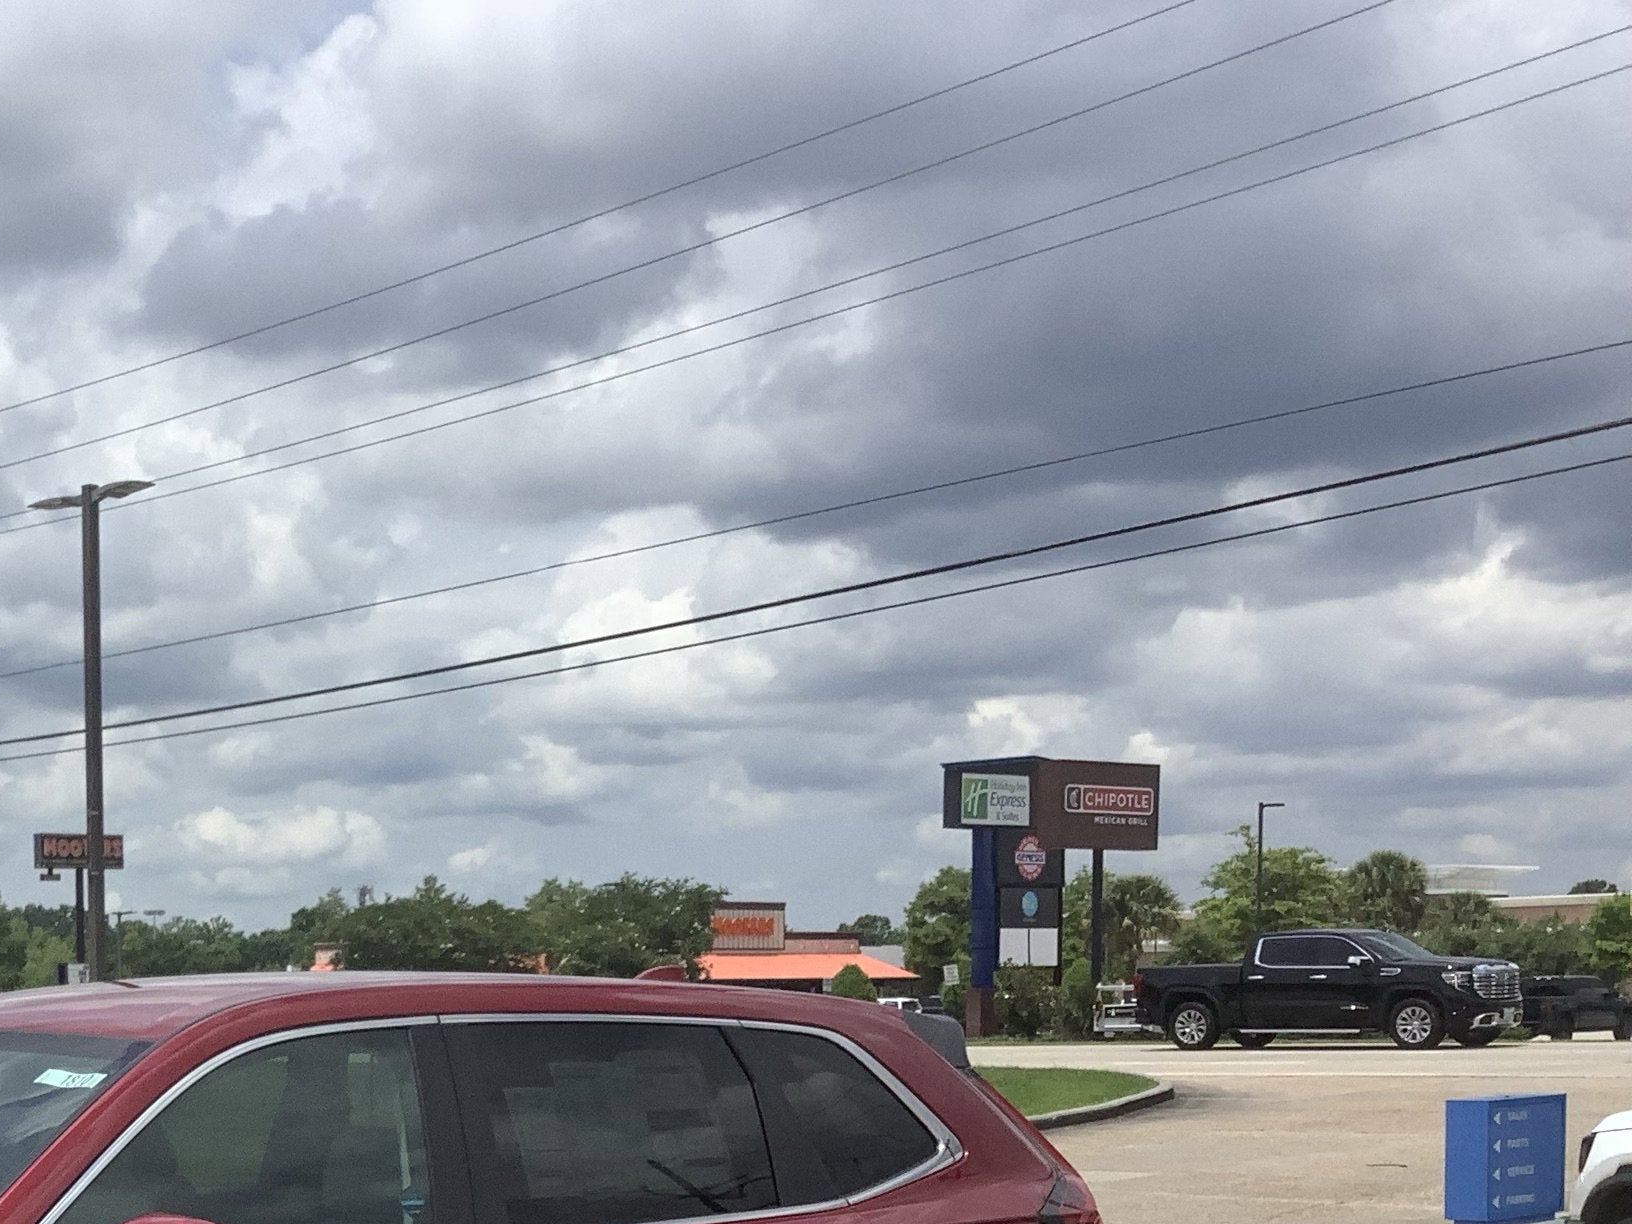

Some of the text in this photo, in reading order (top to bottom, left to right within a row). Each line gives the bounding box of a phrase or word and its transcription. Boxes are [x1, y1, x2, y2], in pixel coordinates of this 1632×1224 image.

[990, 792, 1027, 810] Express
[1085, 792, 1149, 809] CHIPOTLE
[1094, 816, 1148, 826] MEXICAN GRILL
